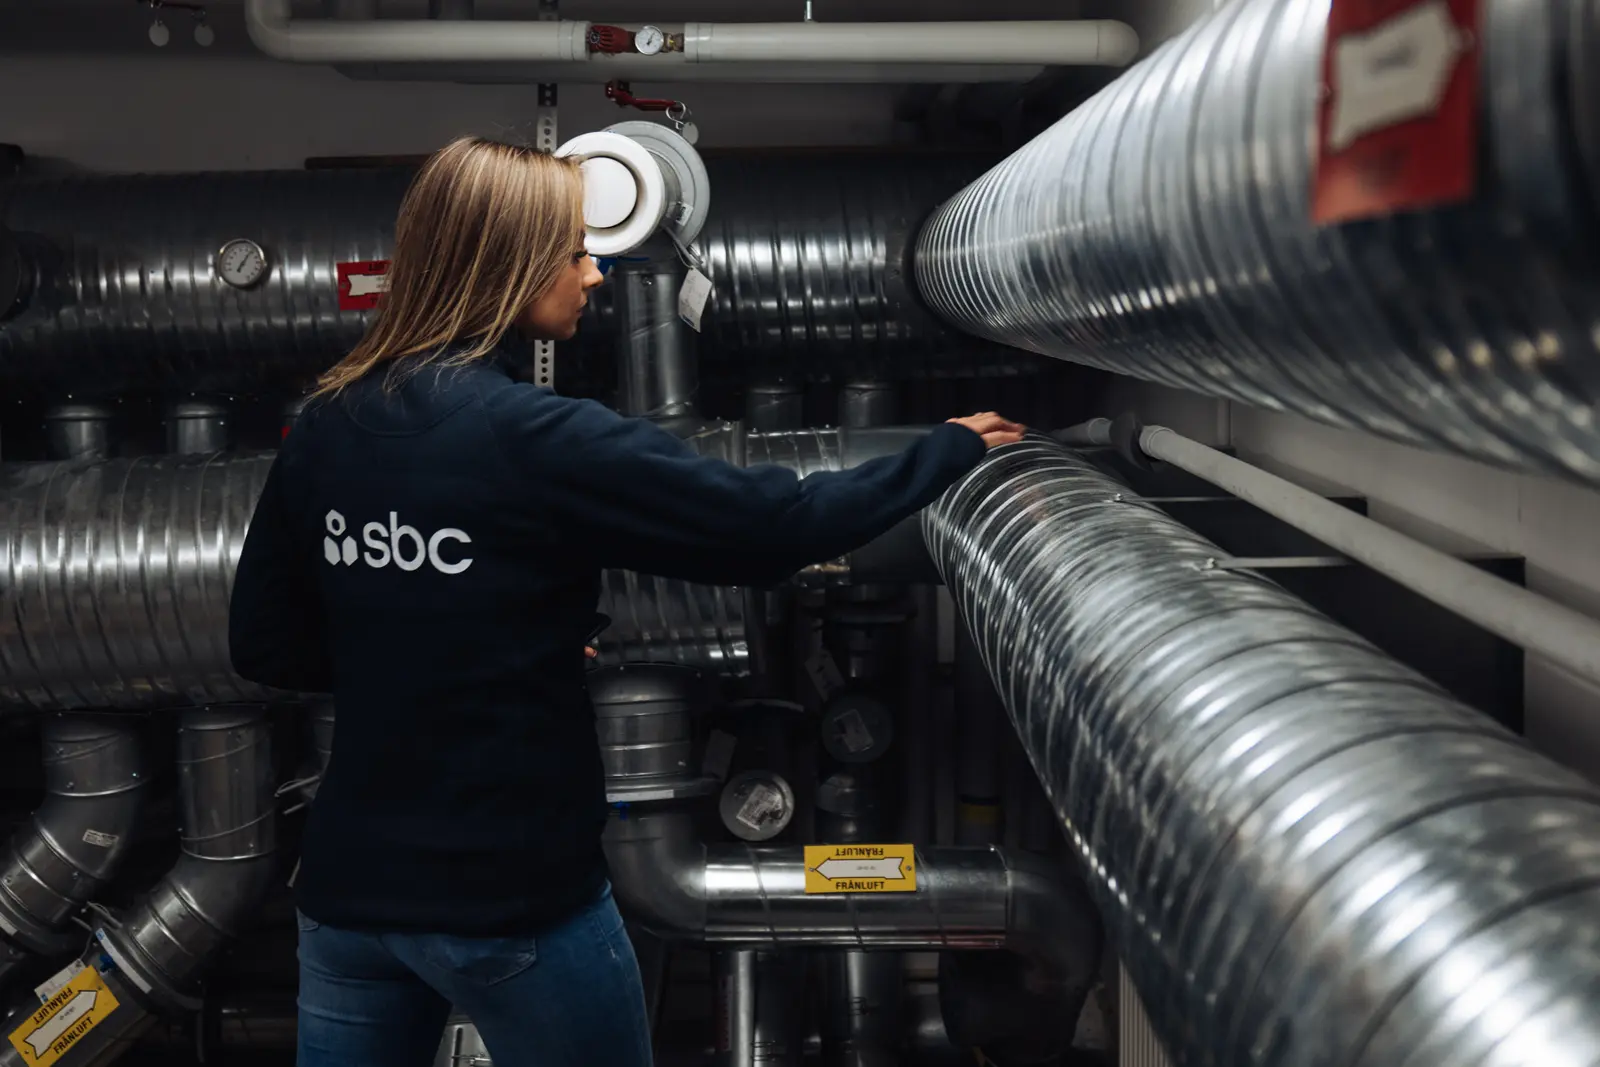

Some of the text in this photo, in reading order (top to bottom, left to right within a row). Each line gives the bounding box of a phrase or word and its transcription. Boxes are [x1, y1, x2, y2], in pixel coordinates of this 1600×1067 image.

[362, 511, 473, 574] sbc
[836, 848, 884, 857] FRÅNLUFT
[835, 881, 885, 890] FRÅNLUFT
[33, 987, 73, 1024] FRÅNLUFT
[53, 1016, 93, 1054] FRÅNLUFT
